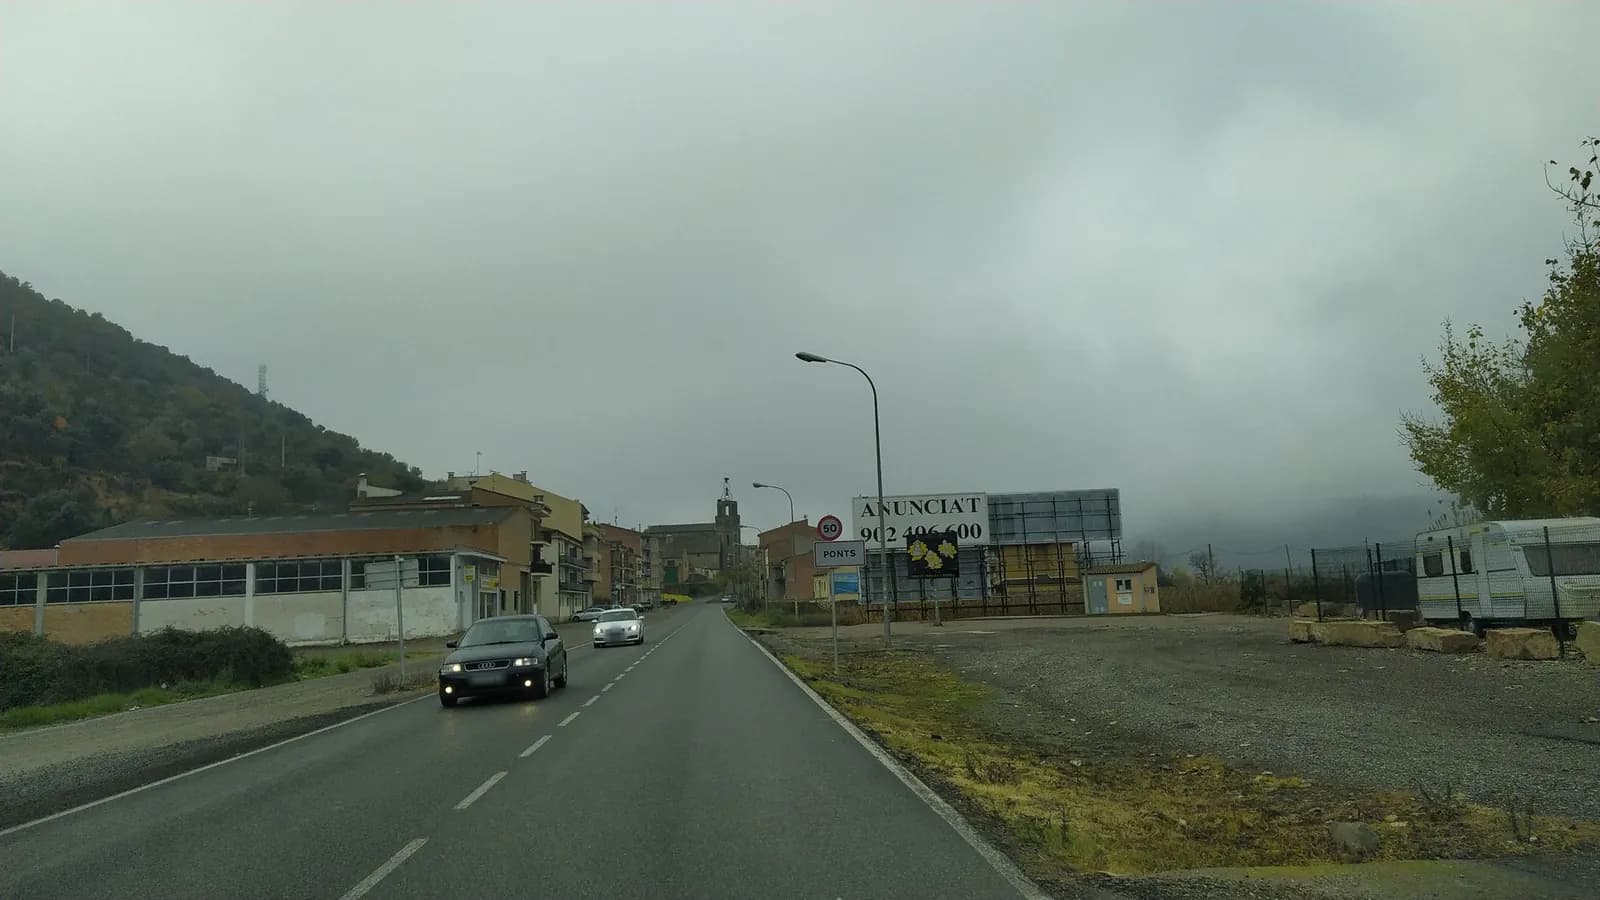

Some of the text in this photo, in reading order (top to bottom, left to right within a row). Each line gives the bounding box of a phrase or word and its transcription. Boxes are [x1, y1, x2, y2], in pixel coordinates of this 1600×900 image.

[861, 497, 981, 518] ANUNCIA'T
[823, 523, 838, 533] 50
[860, 526, 897, 542] 902
[823, 549, 856, 559] PONTS
